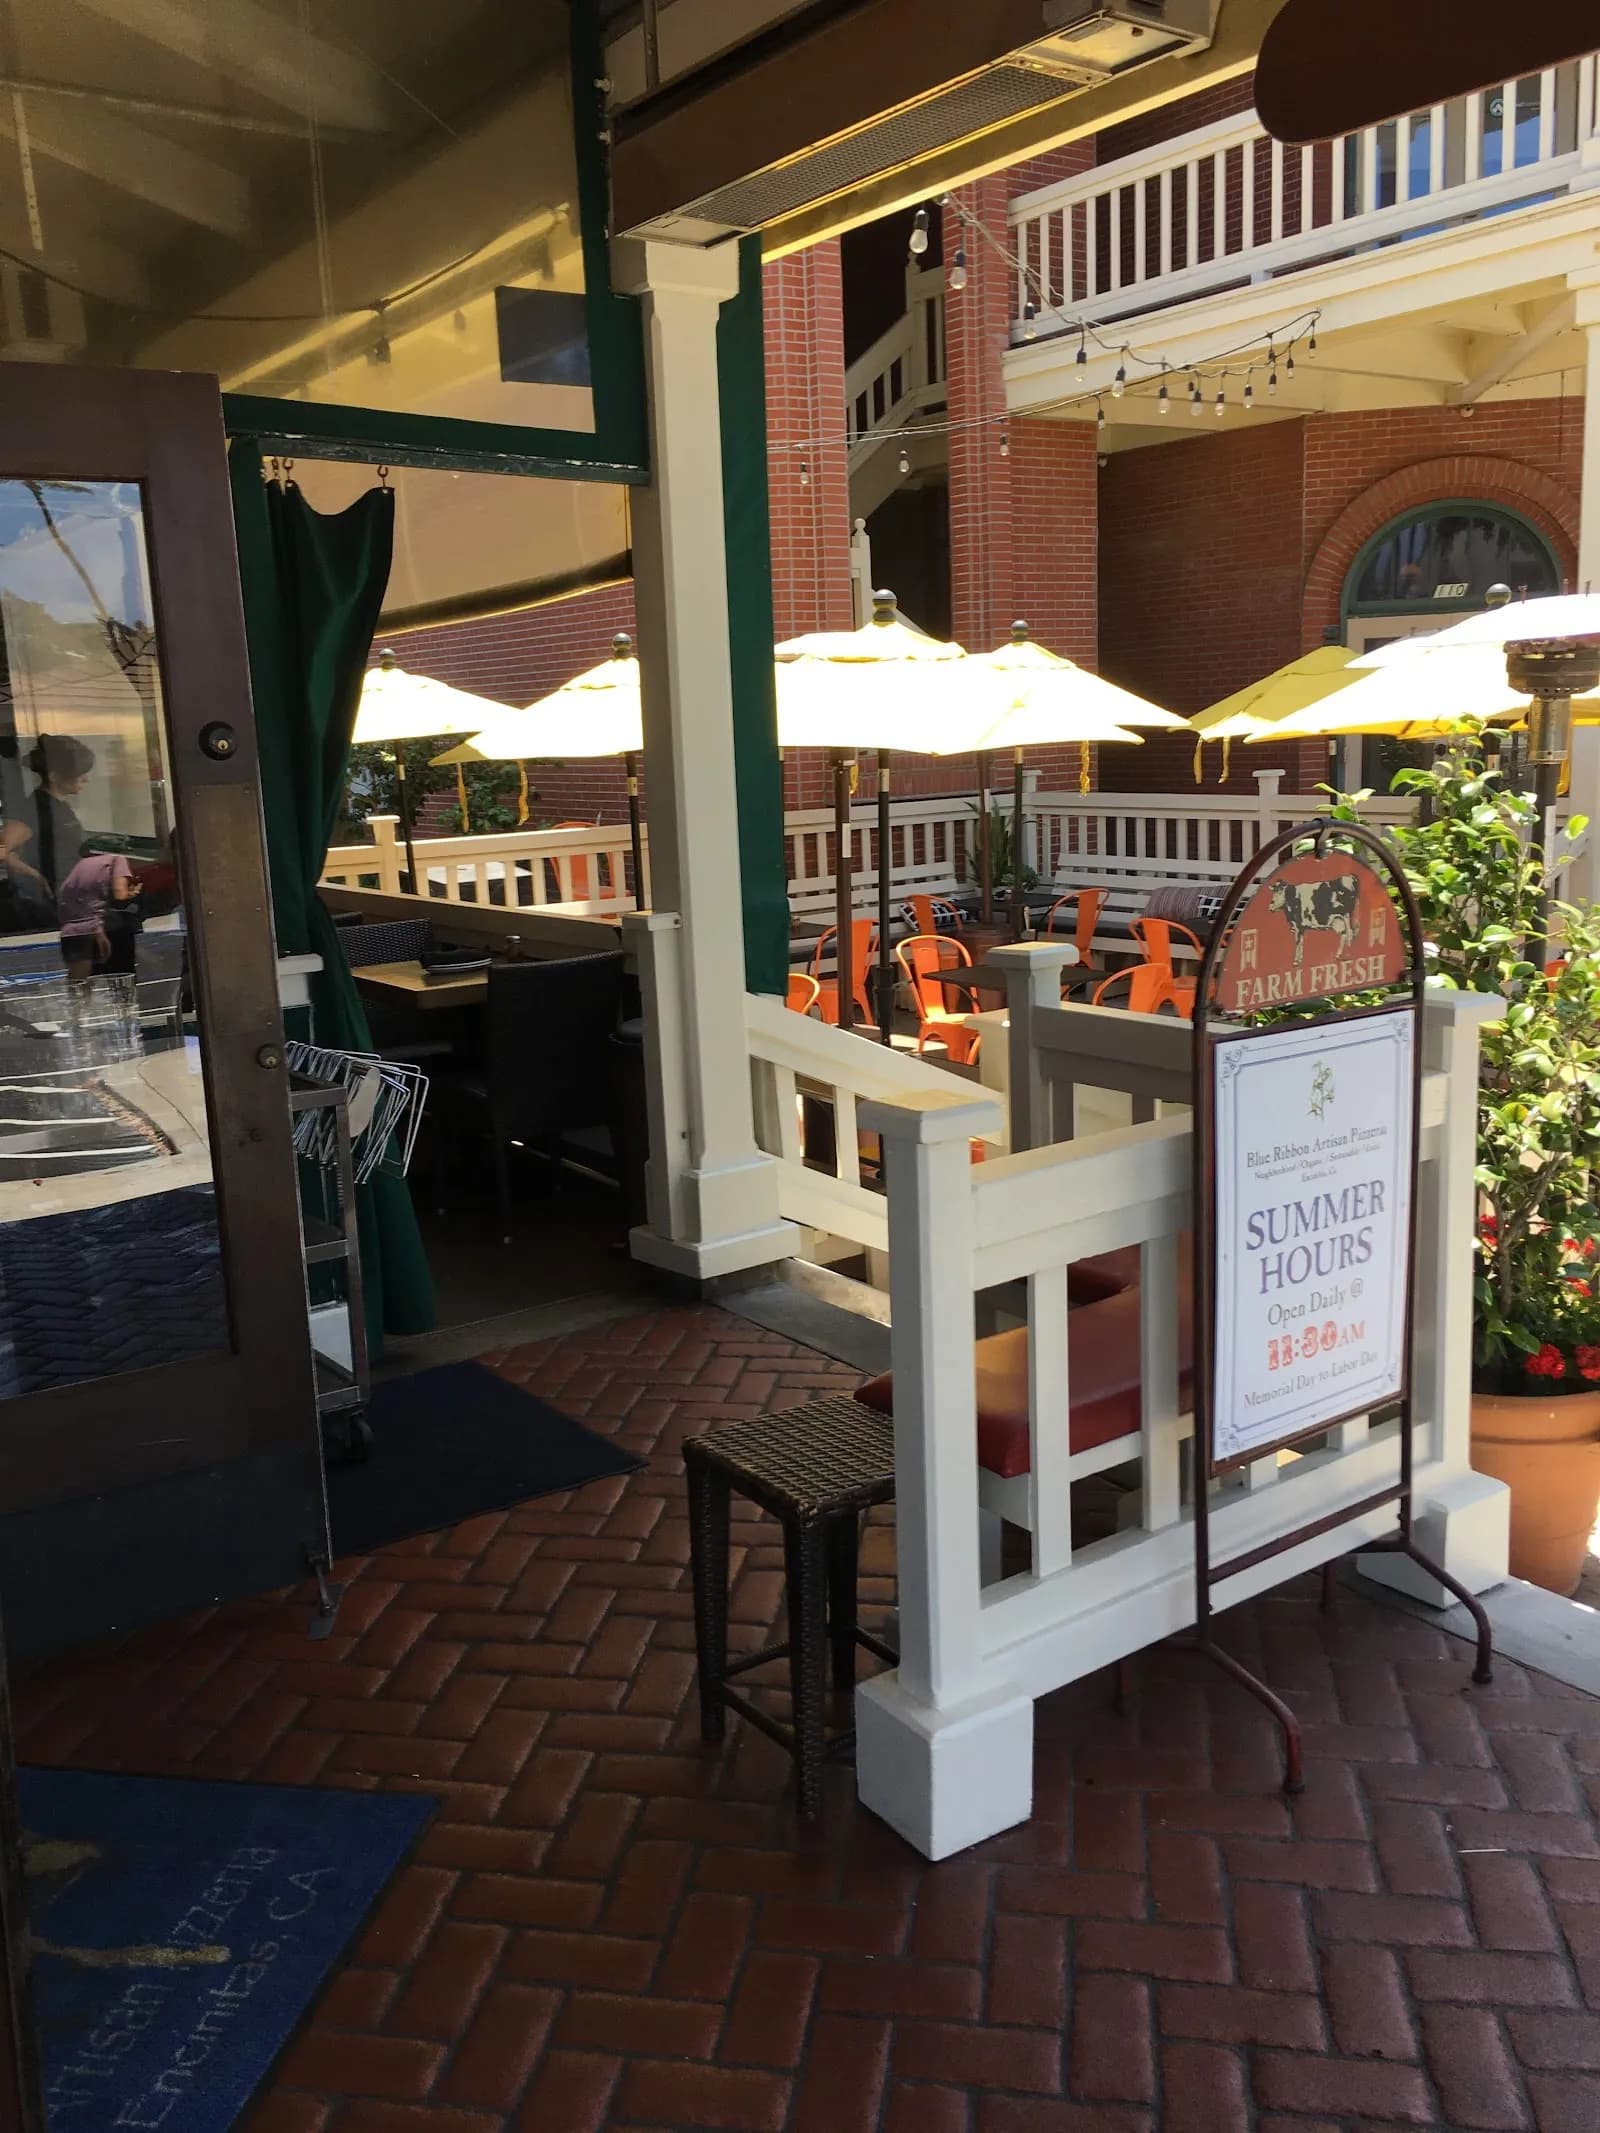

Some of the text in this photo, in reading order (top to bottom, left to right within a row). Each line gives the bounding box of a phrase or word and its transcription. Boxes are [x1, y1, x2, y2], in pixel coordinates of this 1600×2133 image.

[1236, 954, 1386, 1008] FARM FRESH
[1246, 1151, 1271, 1168] Blue
[1273, 1143, 1310, 1162] Ribbon
[1313, 1134, 1348, 1153] Artisan
[1245, 1179, 1386, 1251] SUMMER
[1259, 1225, 1374, 1295] HOURS
[1267, 1277, 1364, 1328] Open Daily @
[1243, 1380, 1295, 1410] Memorial
[1296, 1373, 1315, 1392] Day
[1330, 1358, 1359, 1378] Labor
[269, 1866, 337, 1922] CA
